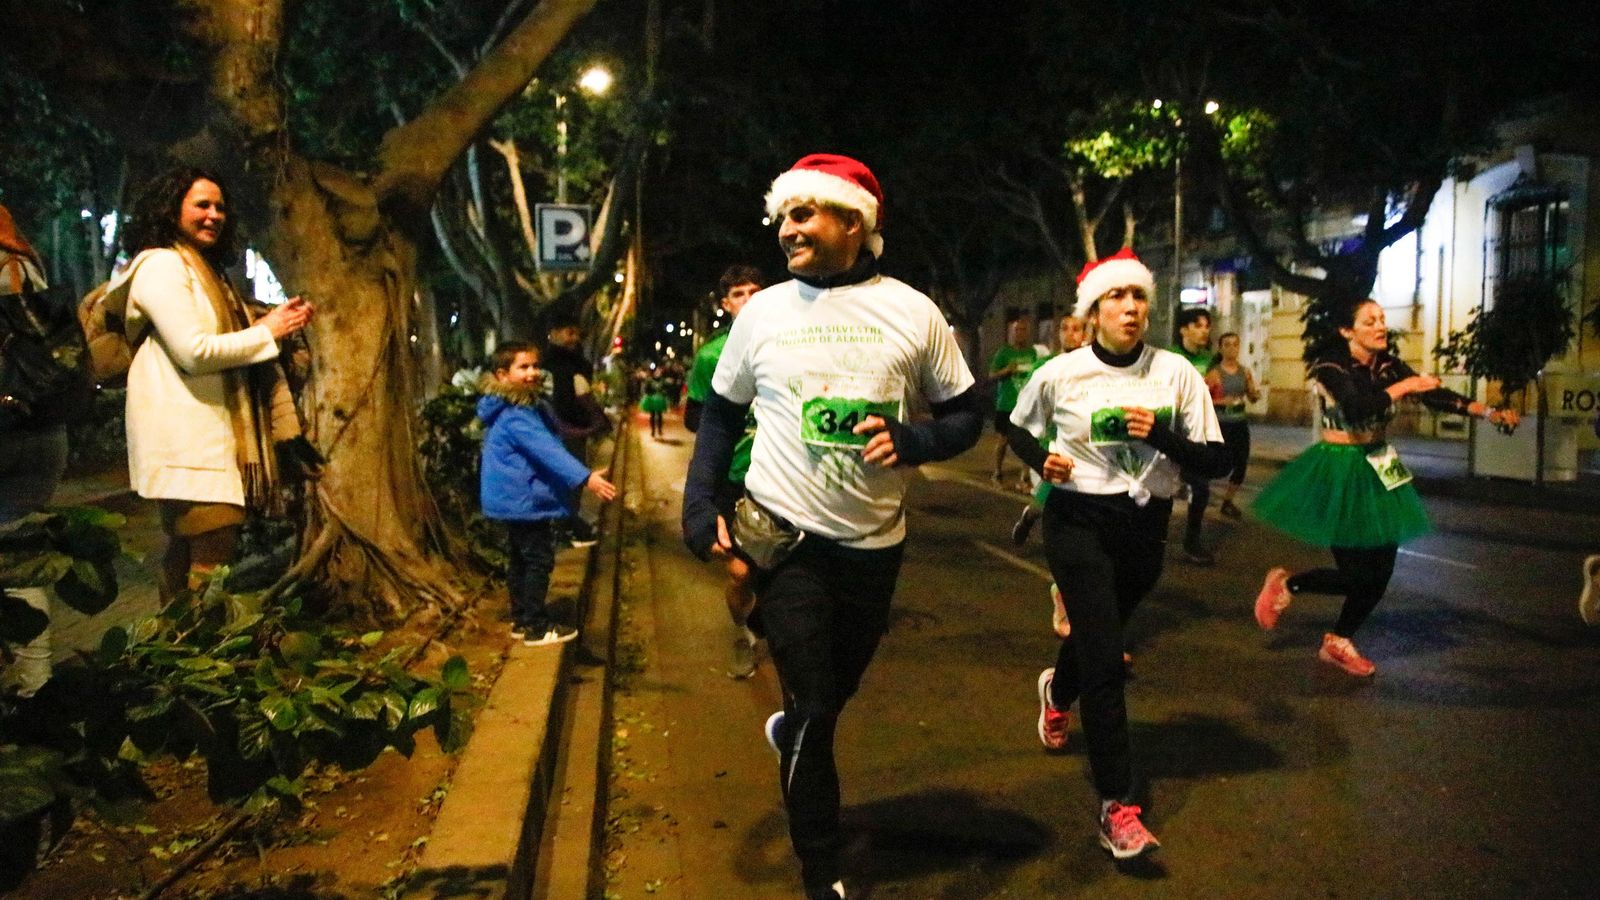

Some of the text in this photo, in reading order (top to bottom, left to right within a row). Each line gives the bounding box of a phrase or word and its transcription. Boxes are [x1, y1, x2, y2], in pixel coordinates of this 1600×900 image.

[542, 209, 586, 260] P
[801, 325, 822, 336] SAN
[819, 335, 831, 344] DE
[1563, 389, 1600, 412] RO
